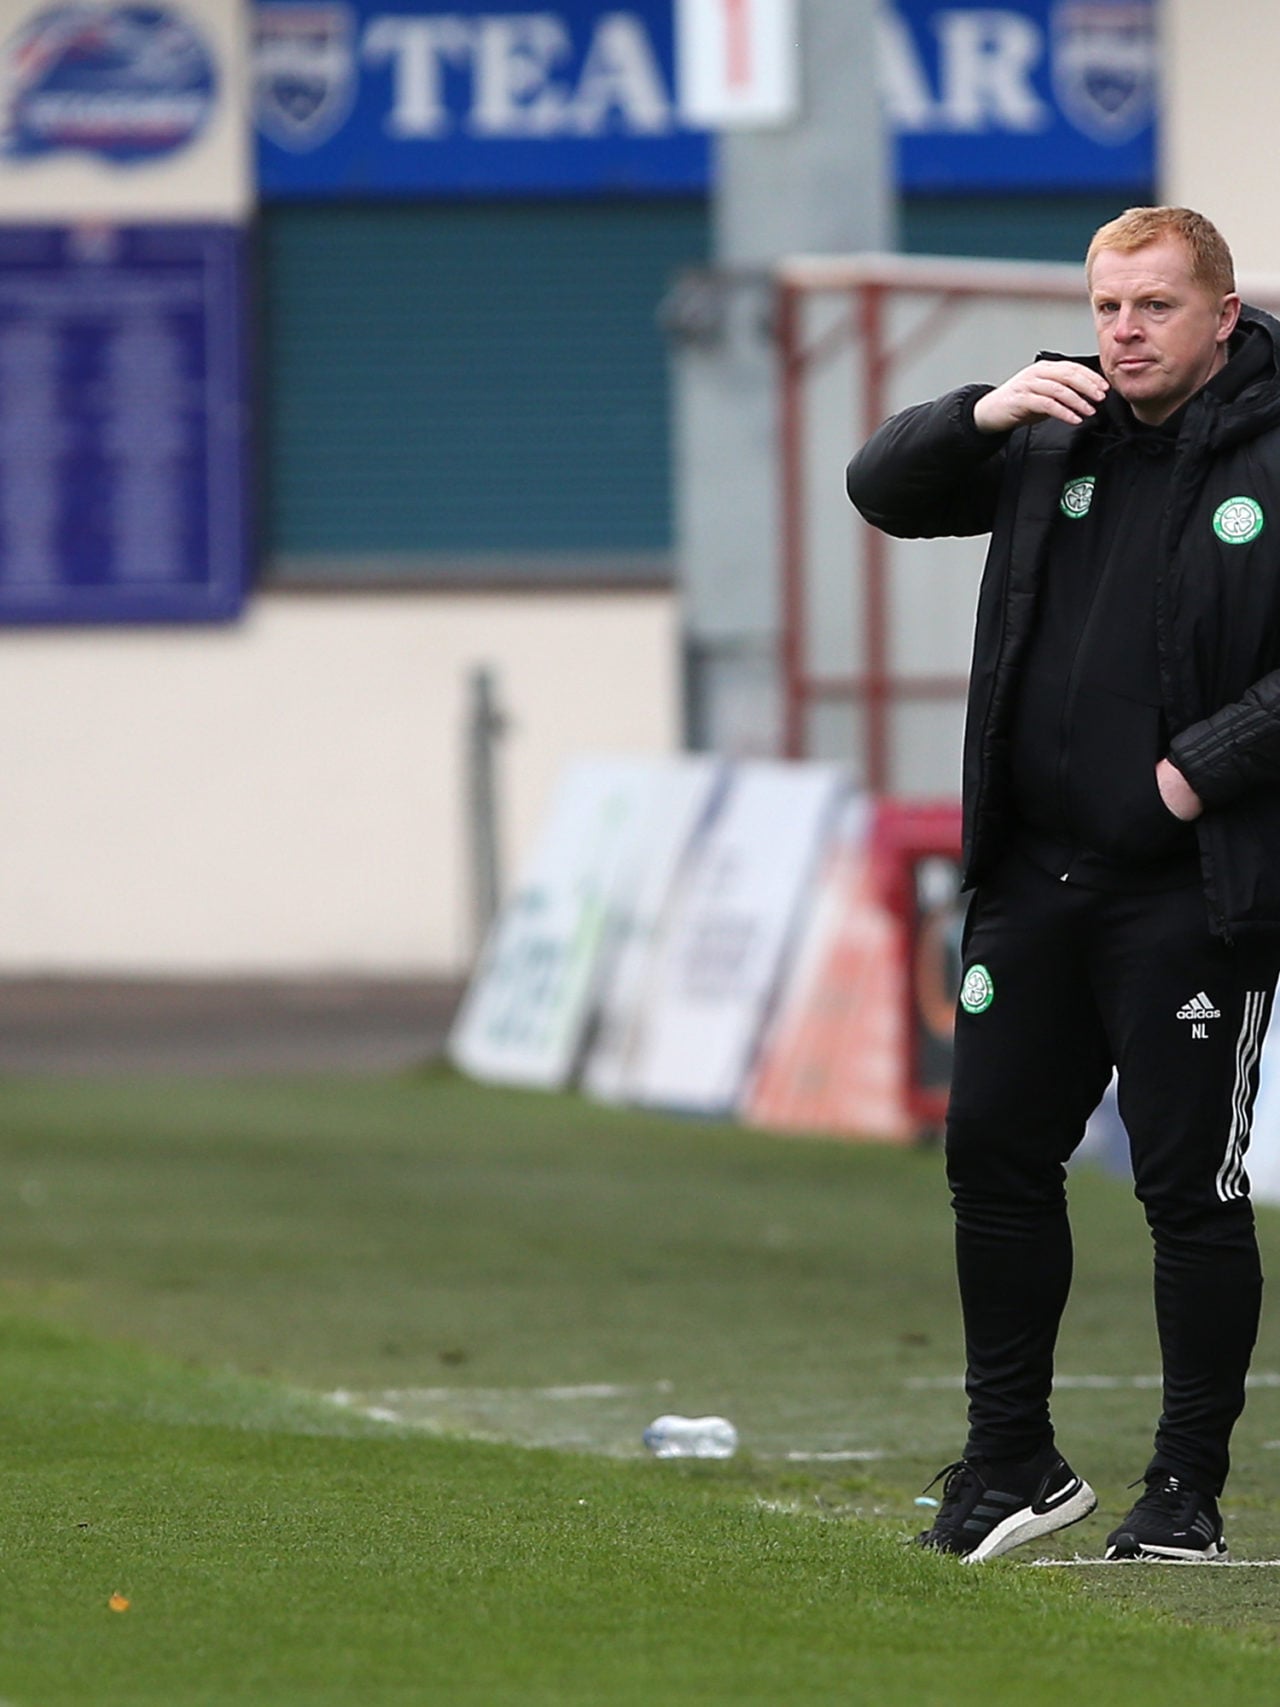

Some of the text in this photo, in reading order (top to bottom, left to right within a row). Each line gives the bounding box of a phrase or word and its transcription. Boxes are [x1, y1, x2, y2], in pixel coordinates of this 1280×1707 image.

[363, 13, 672, 137] TEA
[872, 8, 1052, 132] AR
[1176, 1009, 1221, 1020] adidas
[1192, 1023, 1209, 1039] NL
